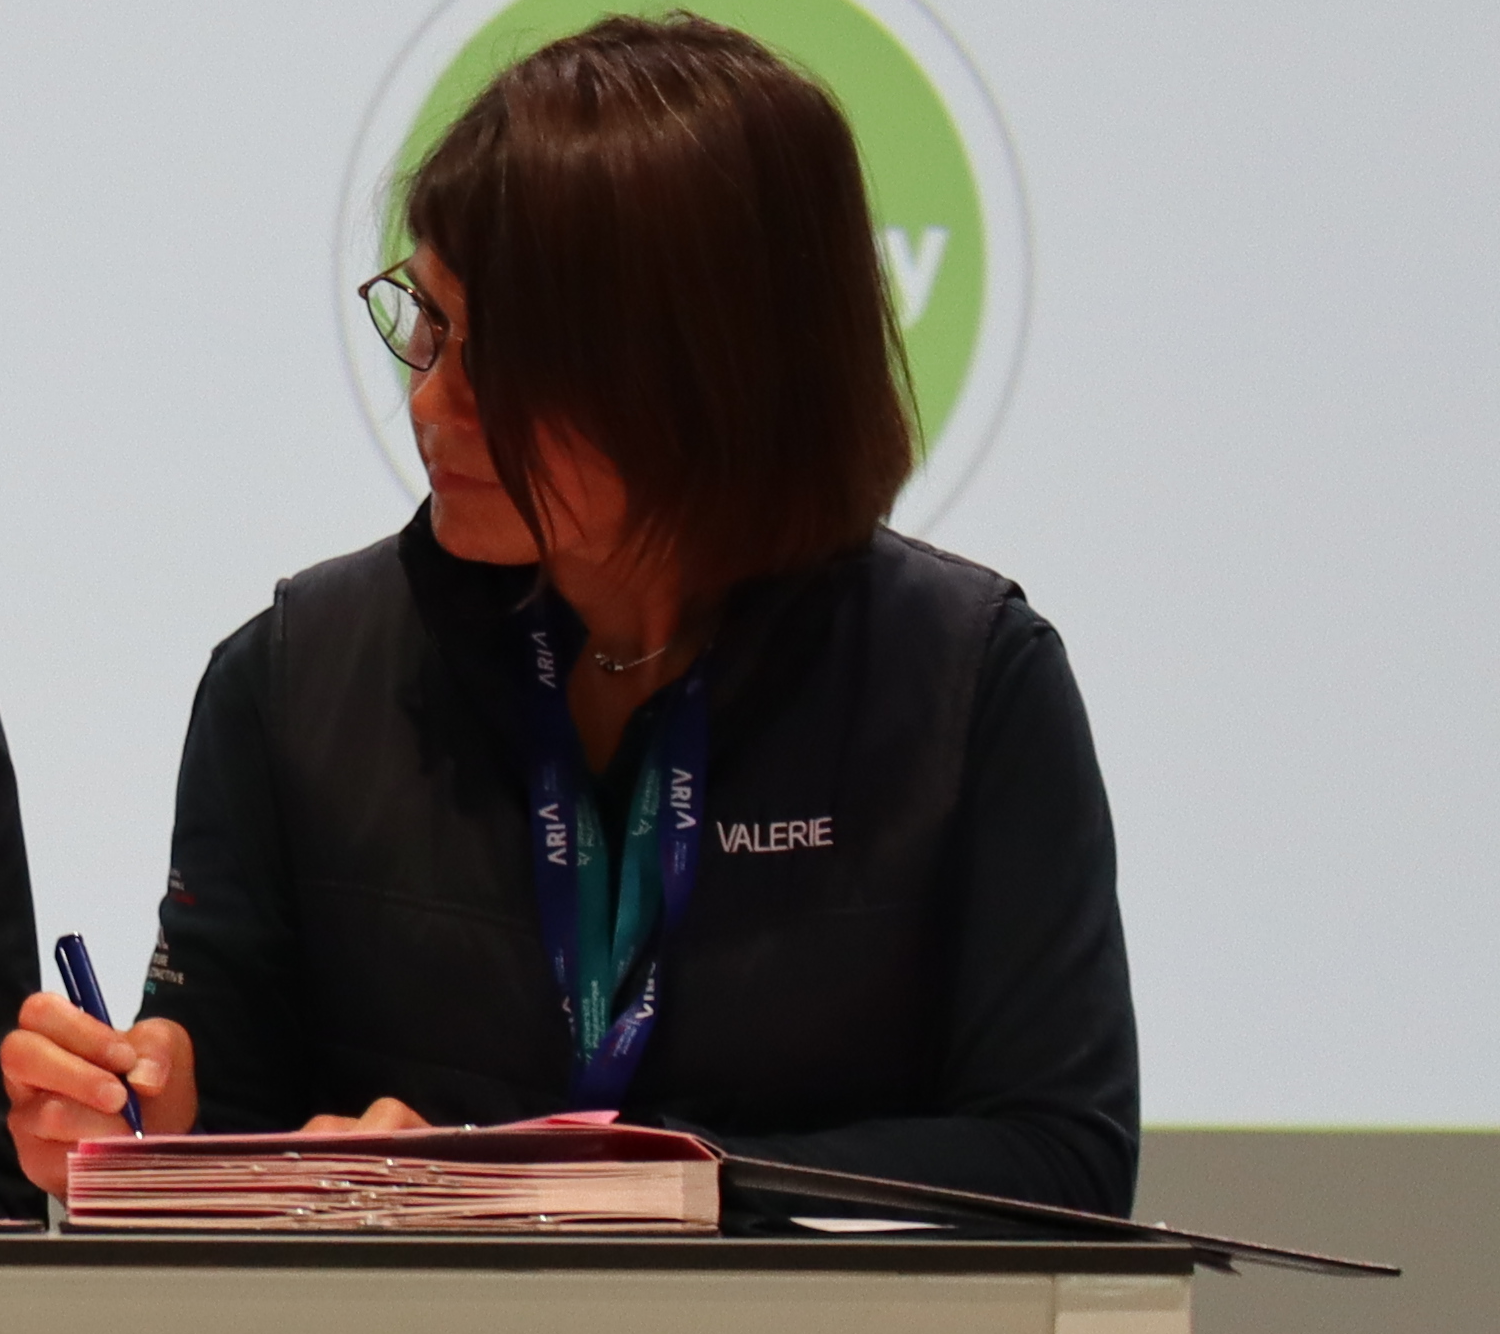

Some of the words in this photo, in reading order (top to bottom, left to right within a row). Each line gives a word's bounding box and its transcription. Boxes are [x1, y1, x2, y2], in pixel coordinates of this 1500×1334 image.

[531, 631, 557, 689] ARIA
[671, 767, 696, 830] ARIA
[538, 802, 567, 865] ARIA
[716, 817, 833, 853] VALERIE
